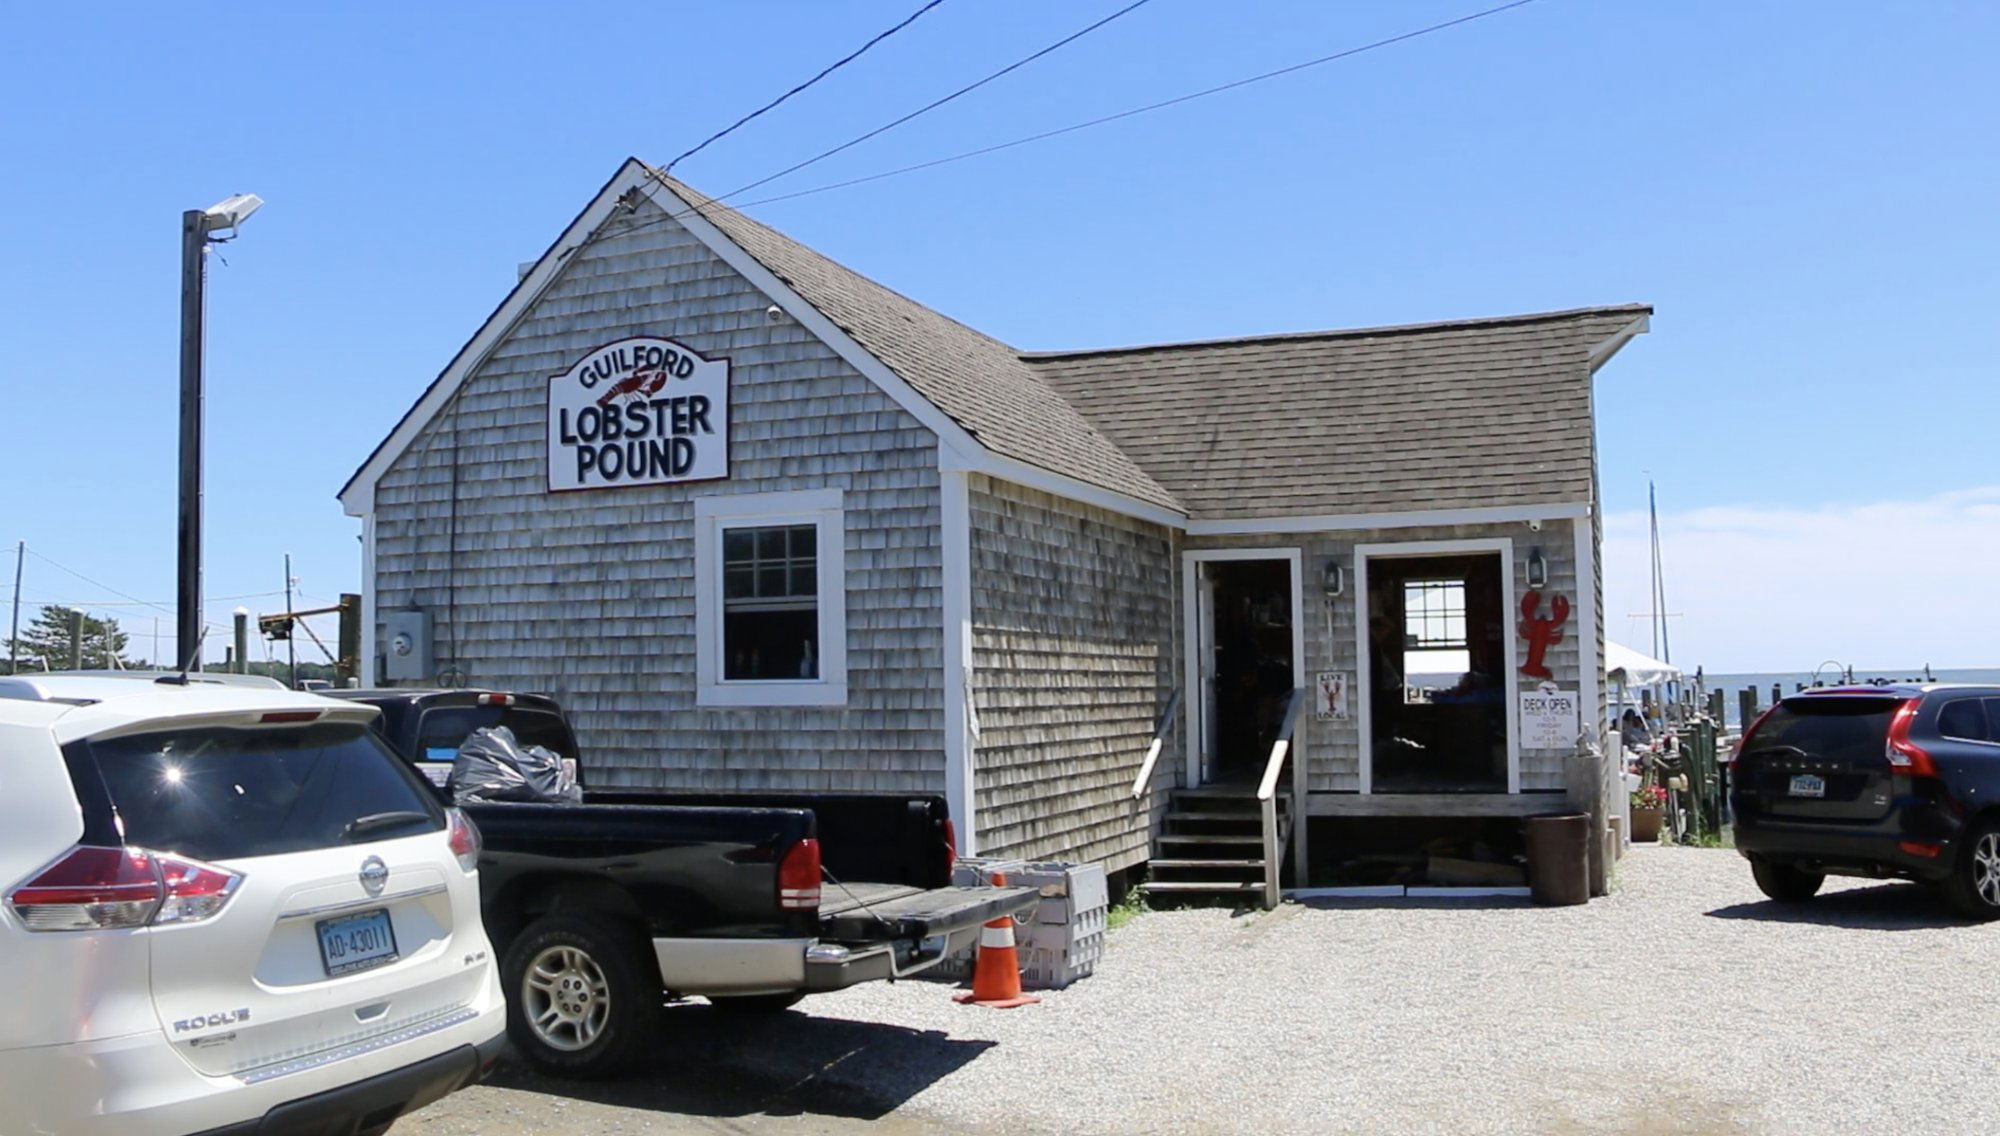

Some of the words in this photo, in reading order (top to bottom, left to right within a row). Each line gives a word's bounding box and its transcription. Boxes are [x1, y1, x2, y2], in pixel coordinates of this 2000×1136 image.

[579, 346, 695, 389] GUILFORD
[560, 395, 715, 444] LOBSTER
[577, 438, 696, 483] POUND
[1524, 698, 1547, 711] DECK
[1549, 698, 1572, 711] OPEN
